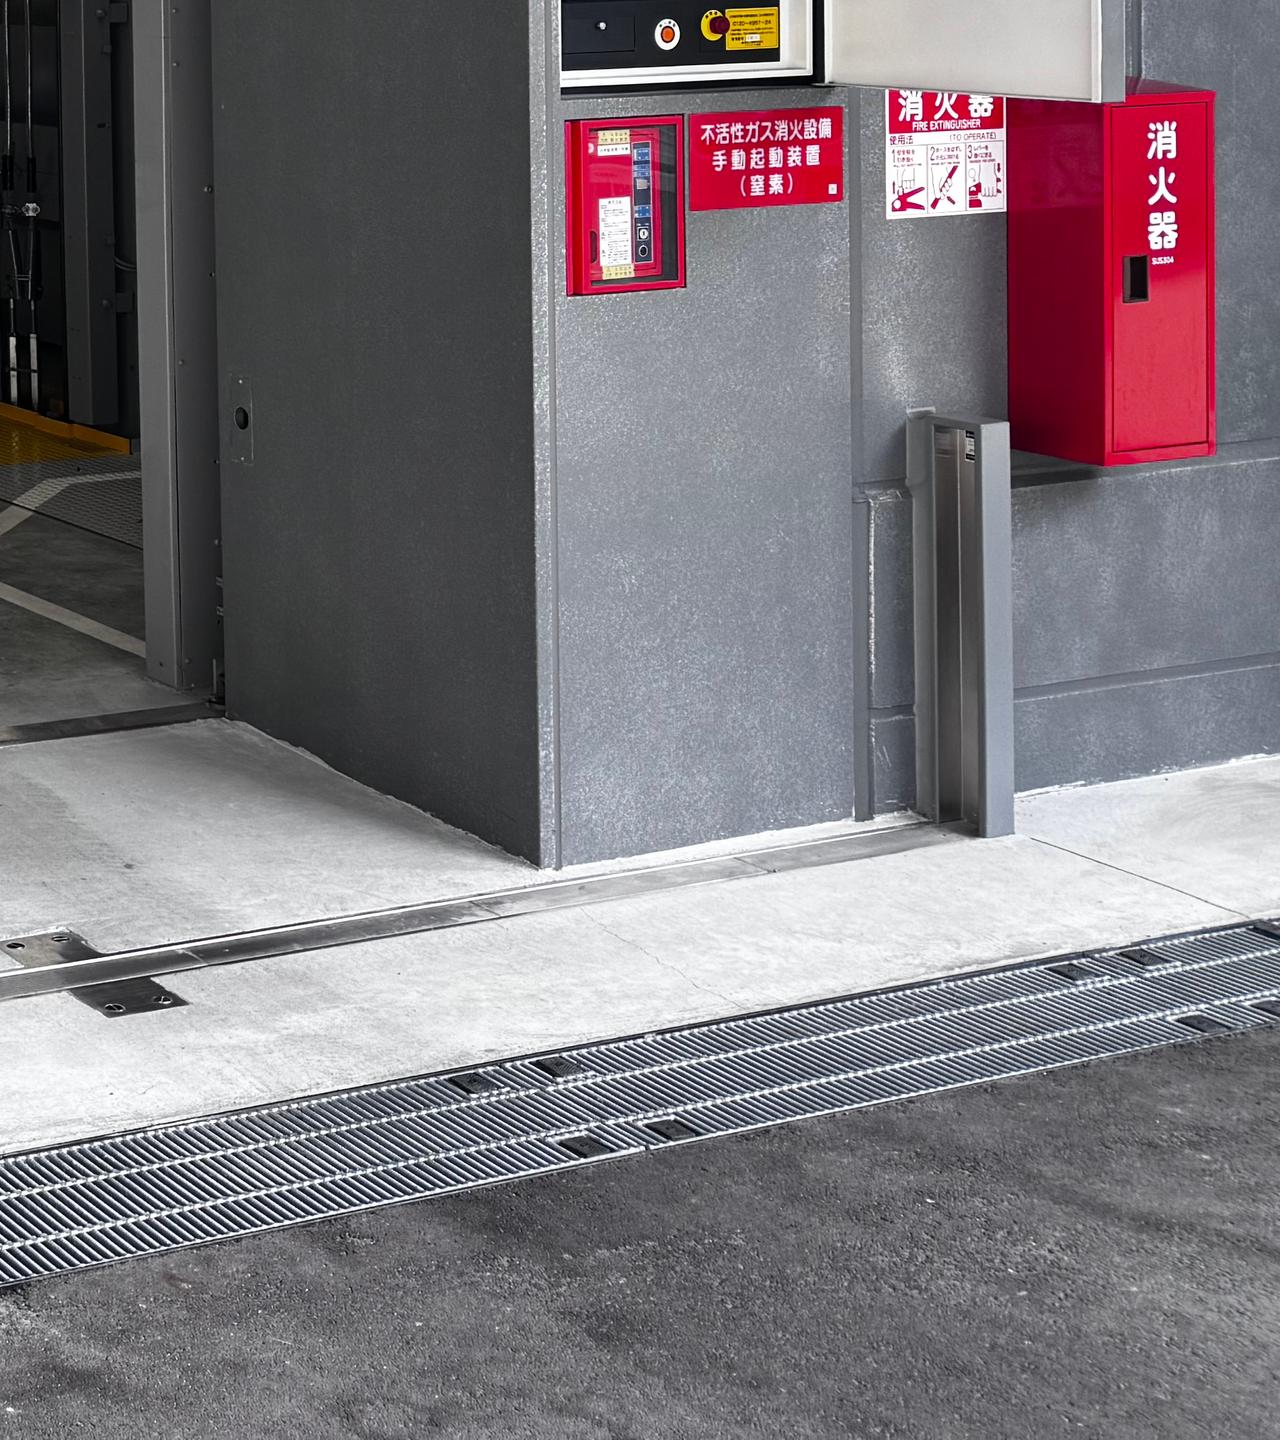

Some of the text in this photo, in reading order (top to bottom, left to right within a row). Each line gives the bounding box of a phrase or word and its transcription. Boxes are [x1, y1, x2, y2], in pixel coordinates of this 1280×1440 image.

[898, 90, 994, 121] 消火器
[700, 117, 832, 146] 不活性ガス消火設備
[912, 119, 981, 131] FIRE EXTINGUISHER
[712, 145, 821, 172] 手動起動装置
[1147, 120, 1178, 251] 消火器
